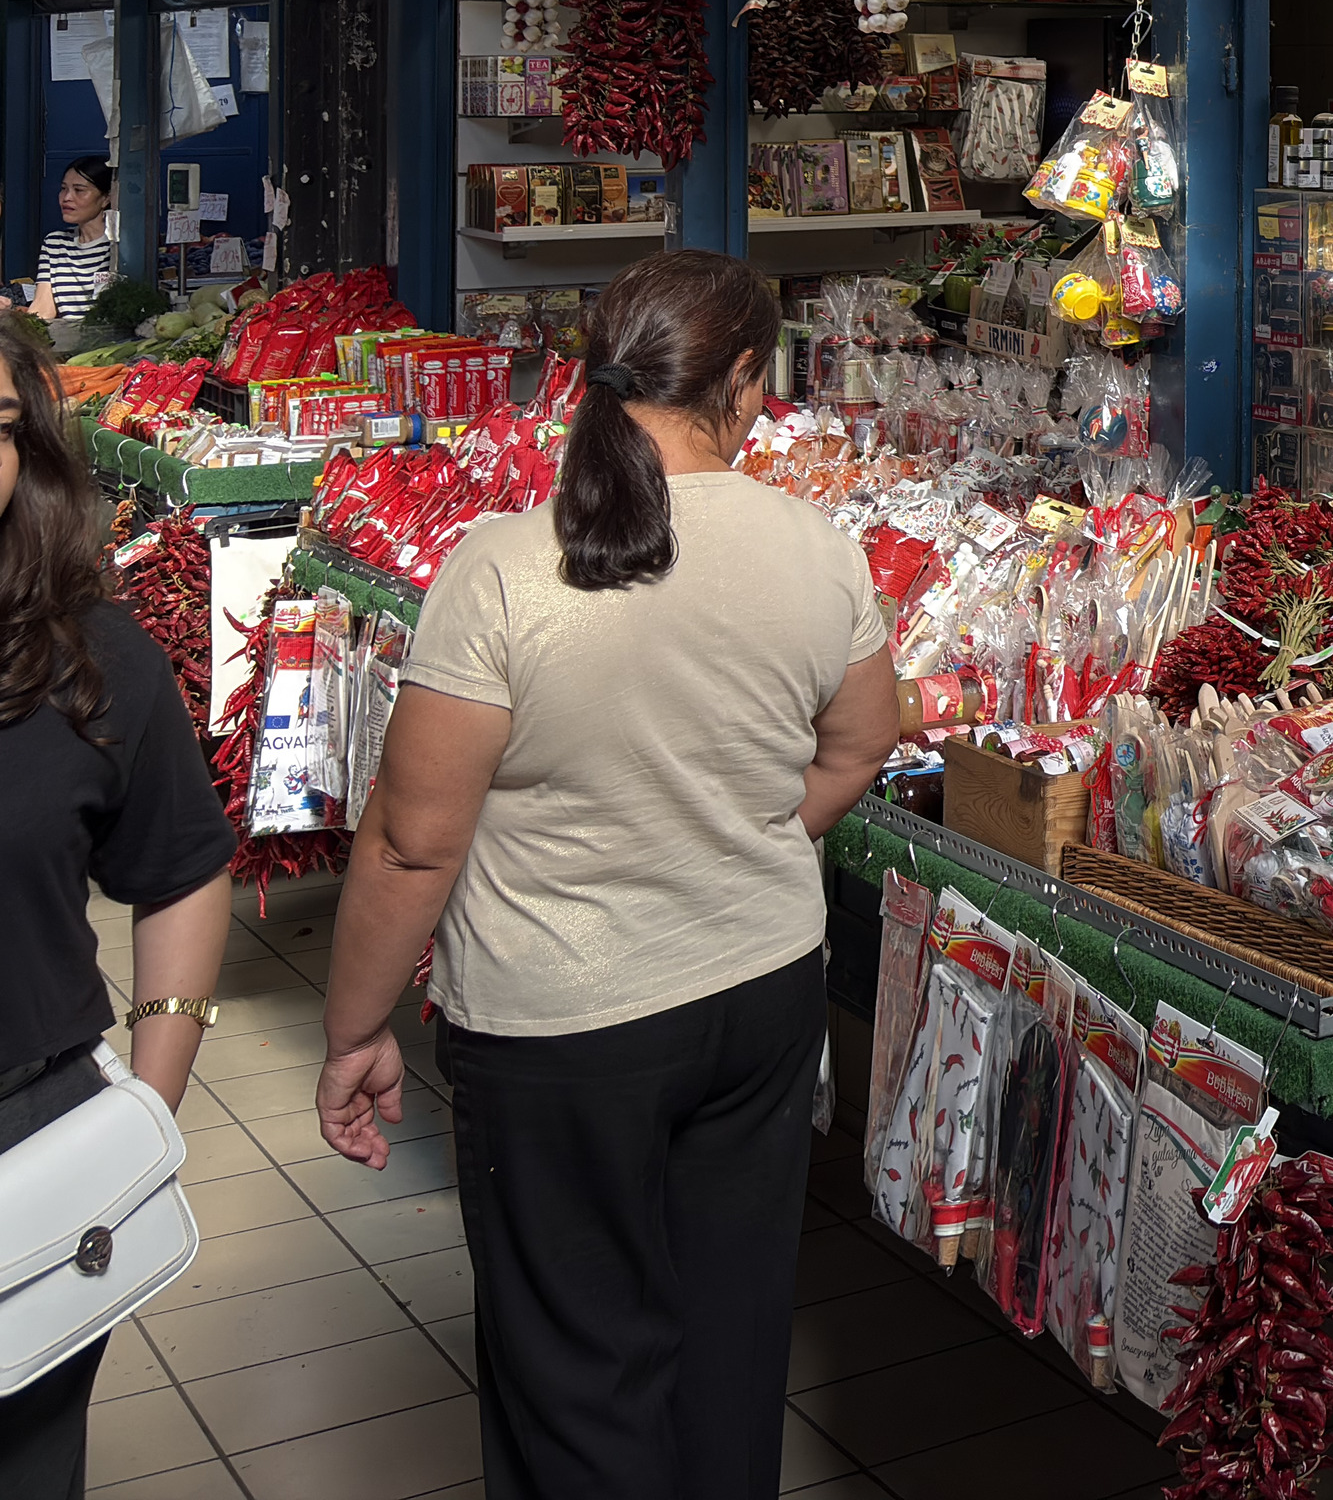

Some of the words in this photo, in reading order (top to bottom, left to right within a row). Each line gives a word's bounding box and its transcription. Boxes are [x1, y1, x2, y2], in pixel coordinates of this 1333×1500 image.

[529, 61, 548, 69] TEA
[969, 947, 1005, 981] BUDAPEST
[1206, 1070, 1254, 1112] BUDAPEST
